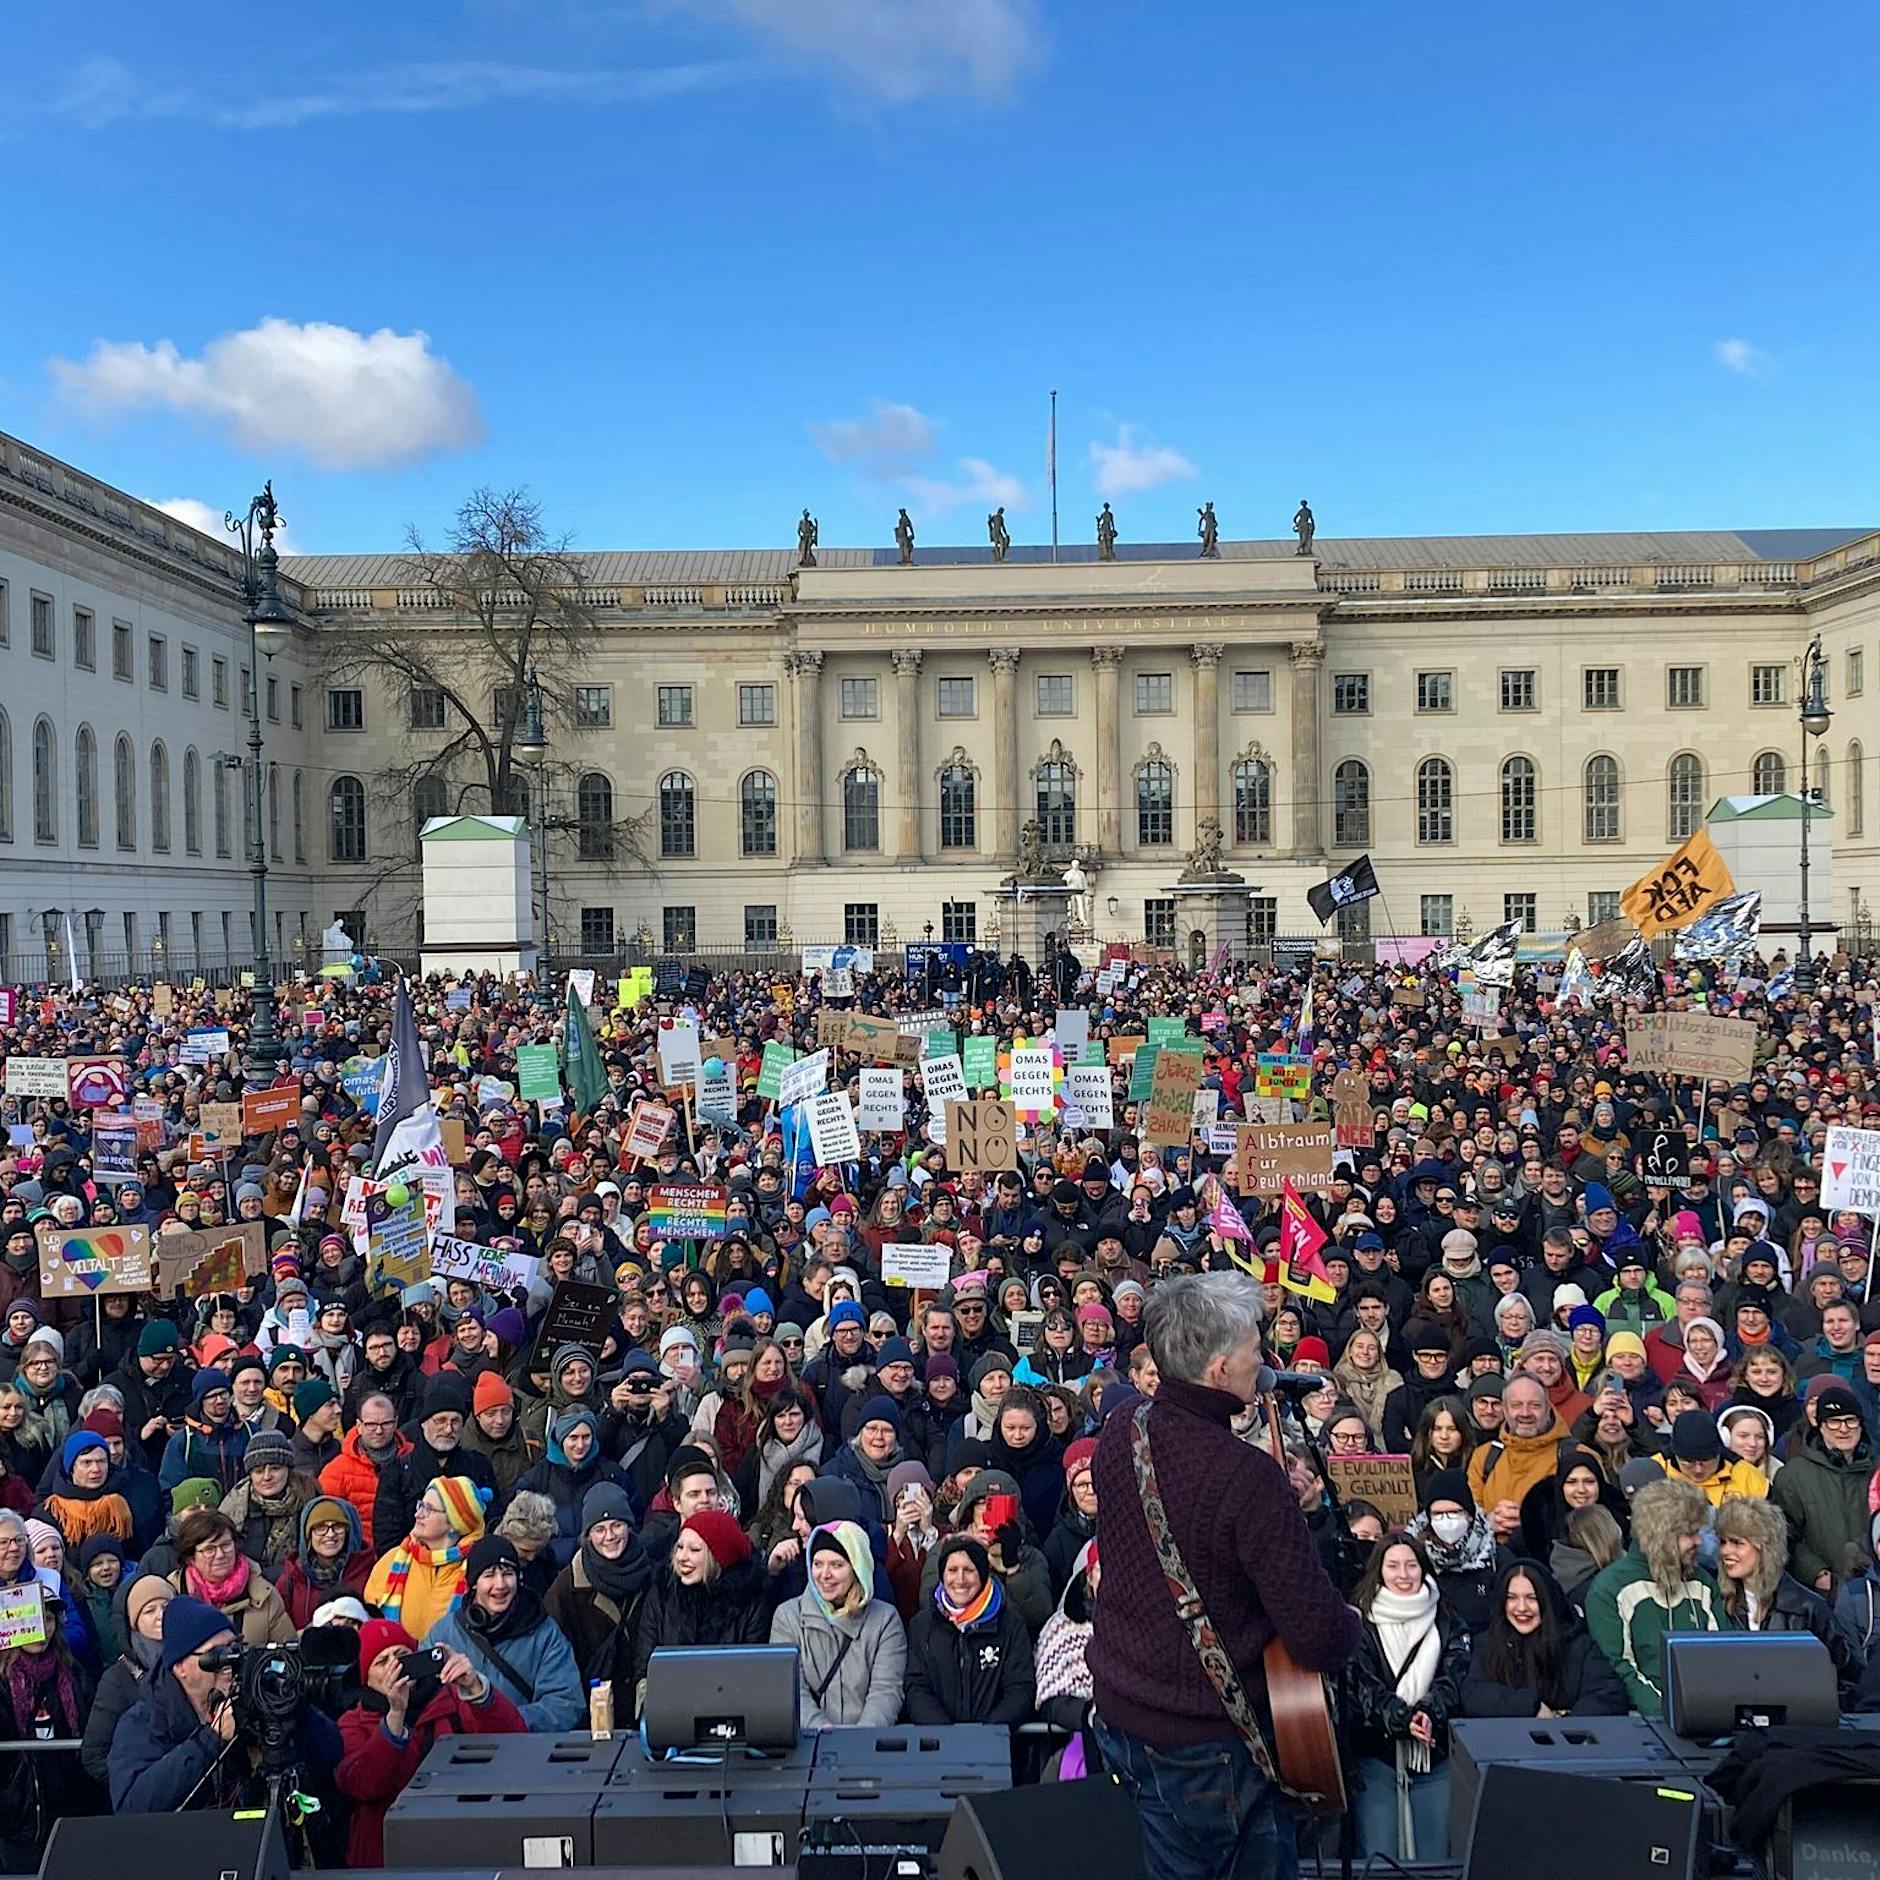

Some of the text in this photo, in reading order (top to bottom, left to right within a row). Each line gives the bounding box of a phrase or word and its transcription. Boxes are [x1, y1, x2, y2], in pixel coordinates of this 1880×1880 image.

[864, 622, 1012, 634] HUMBOLDT
[824, 1023, 847, 1033] FCK
[1015, 1056, 1048, 1064] OMAS
[928, 1061, 955, 1073] OMAS
[868, 1076, 894, 1084] OMAS
[928, 1072, 959, 1085] GEGEN
[1014, 1071, 1050, 1080] GEGEN
[1074, 1075, 1105, 1083] OMAS
[703, 1086, 730, 1094] RECHTS
[865, 1090, 896, 1098] GEGEN
[928, 1083, 964, 1097] RECHTS
[1012, 1087, 1052, 1096] RECHTS
[1073, 1090, 1107, 1099] GEGEN
[816, 1096, 839, 1107] OMAS
[817, 1105, 842, 1116] GEGEN
[864, 1104, 899, 1112] RECHTS
[816, 1114, 846, 1126] RECHTS
[1246, 1131, 1331, 1151] Albtraum
[1247, 1173, 1334, 1190] Deutschland
[1852, 1173, 1871, 1186] VON
[659, 1188, 720, 1199] MENSCHEN
[667, 1199, 709, 1208] RECHTE
[673, 1208, 704, 1218] STATT
[666, 1217, 709, 1227] RECHTE
[656, 1226, 717, 1237] MENSCHEN
[431, 1236, 472, 1267] HASS
[1344, 1460, 1410, 1476] EVOLUTION
[1801, 1843, 1878, 1868] Danke,
